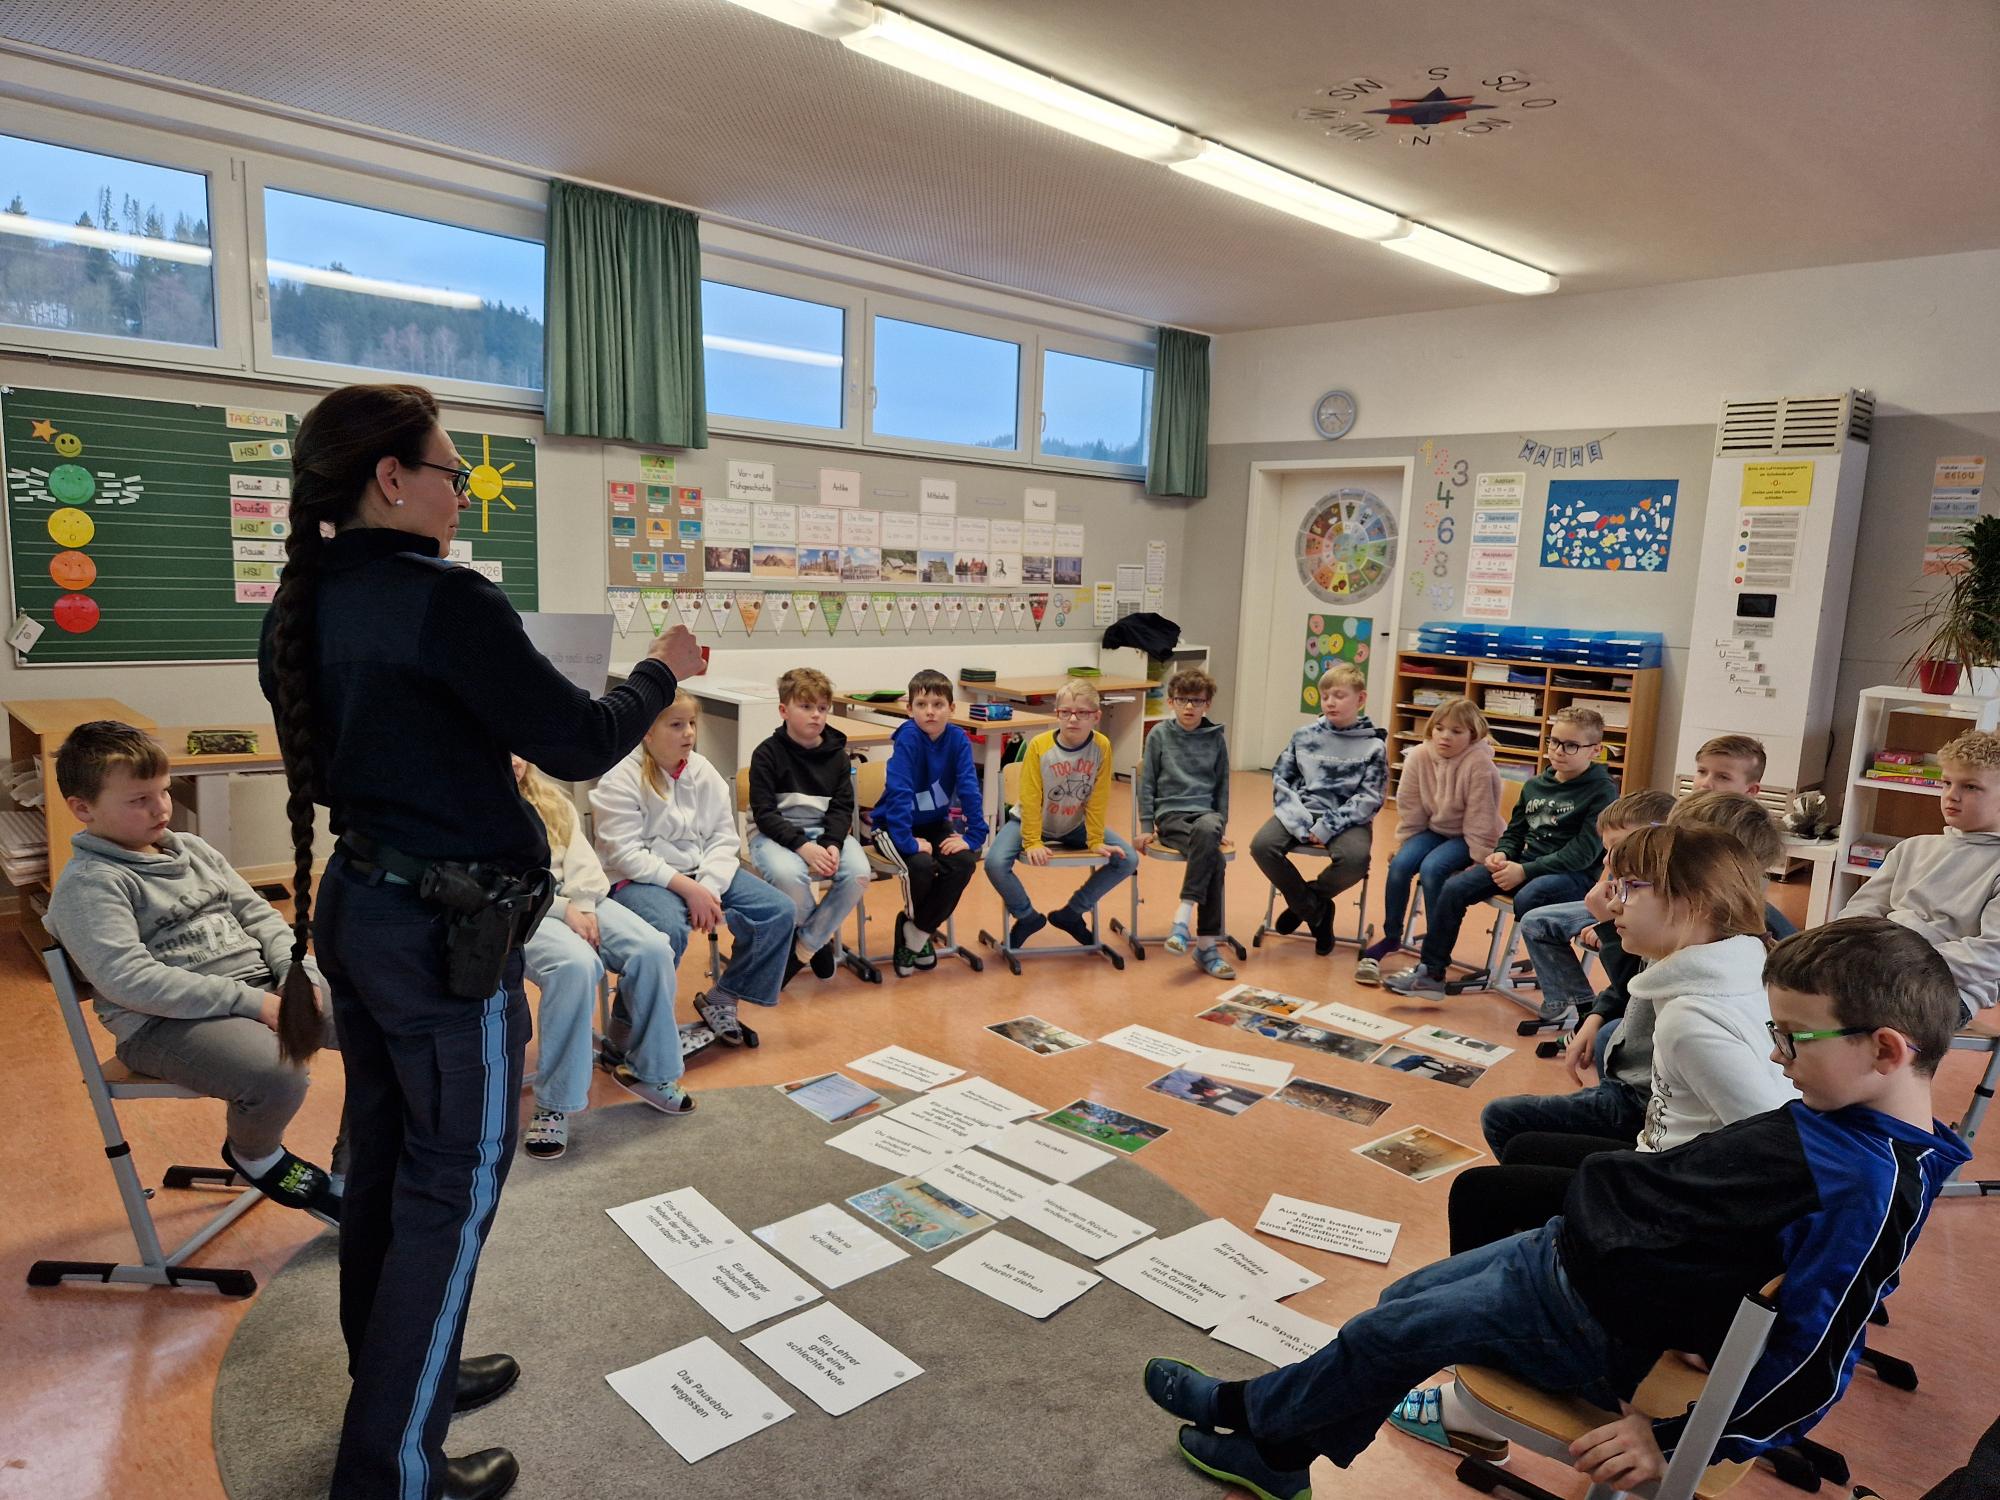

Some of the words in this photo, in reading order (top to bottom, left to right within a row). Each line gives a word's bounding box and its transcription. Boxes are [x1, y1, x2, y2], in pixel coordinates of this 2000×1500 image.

[1428, 67, 1450, 81] S
[240, 447, 259, 457] HSU
[1525, 443, 1599, 462] MATHE
[729, 480, 772, 494] Frühgeschichte
[753, 470, 765, 479] und
[1452, 459, 1470, 487] 3
[234, 502, 268, 514] Deutsch
[1437, 480, 1455, 509] 4
[240, 523, 259, 533] HSU
[1437, 516, 1456, 544] 6
[243, 567, 262, 577] HSU
[1434, 550, 1448, 578] 8
[1330, 1012, 1384, 1030] GEWALT
[1068, 1211, 1087, 1222] dem
[1278, 1207, 1298, 1216] Aus
[1300, 1212, 1326, 1223] Spaß
[1329, 1219, 1364, 1233] bastelt
[1366, 1229, 1383, 1238] ein
[1293, 1217, 1325, 1229] Junge
[1326, 1225, 1339, 1233] an
[1341, 1228, 1360, 1237] der
[809, 1233, 843, 1256] SCHLIMM
[825, 1230, 845, 1243] Nicht
[1260, 1220, 1287, 1231] eines
[1289, 1227, 1350, 1248] Mitschülers
[1352, 1244, 1387, 1257] herum
[1286, 1220, 1364, 1245] Fahrradbremse
[1002, 1263, 1017, 1272] An
[1017, 1269, 1035, 1280] den
[1213, 1246, 1229, 1257] mit
[1228, 1254, 1259, 1277] Pistole
[1221, 1242, 1237, 1253] Ein
[1236, 1251, 1269, 1276] Polizist
[712, 1275, 741, 1299] Schwein
[716, 1265, 752, 1292] schlachtet
[748, 1291, 761, 1301] ein
[731, 1262, 745, 1273] Ein
[743, 1271, 770, 1292] Metzger
[980, 1261, 1012, 1279] Haaren
[1012, 1276, 1045, 1294] ziehen
[1140, 1269, 1200, 1304] beschmieren
[1149, 1256, 1170, 1269] Eine
[1171, 1267, 1197, 1284] weiße
[1198, 1281, 1227, 1299] Wand
[1151, 1266, 1169, 1277] mit
[1168, 1274, 1205, 1297] Graffitis
[1246, 1315, 1269, 1327] Aus
[1271, 1325, 1301, 1343] Spaß
[807, 1344, 829, 1358] gibt
[826, 1356, 846, 1371] eine
[817, 1334, 834, 1347] Ein
[831, 1344, 861, 1366] Lehrer
[1280, 1339, 1313, 1356] raufe
[785, 1341, 826, 1371] schlechte
[823, 1369, 845, 1386] Note
[670, 1383, 709, 1418] wegessen
[676, 1369, 695, 1385] Das
[691, 1383, 734, 1420] Pausebrot
